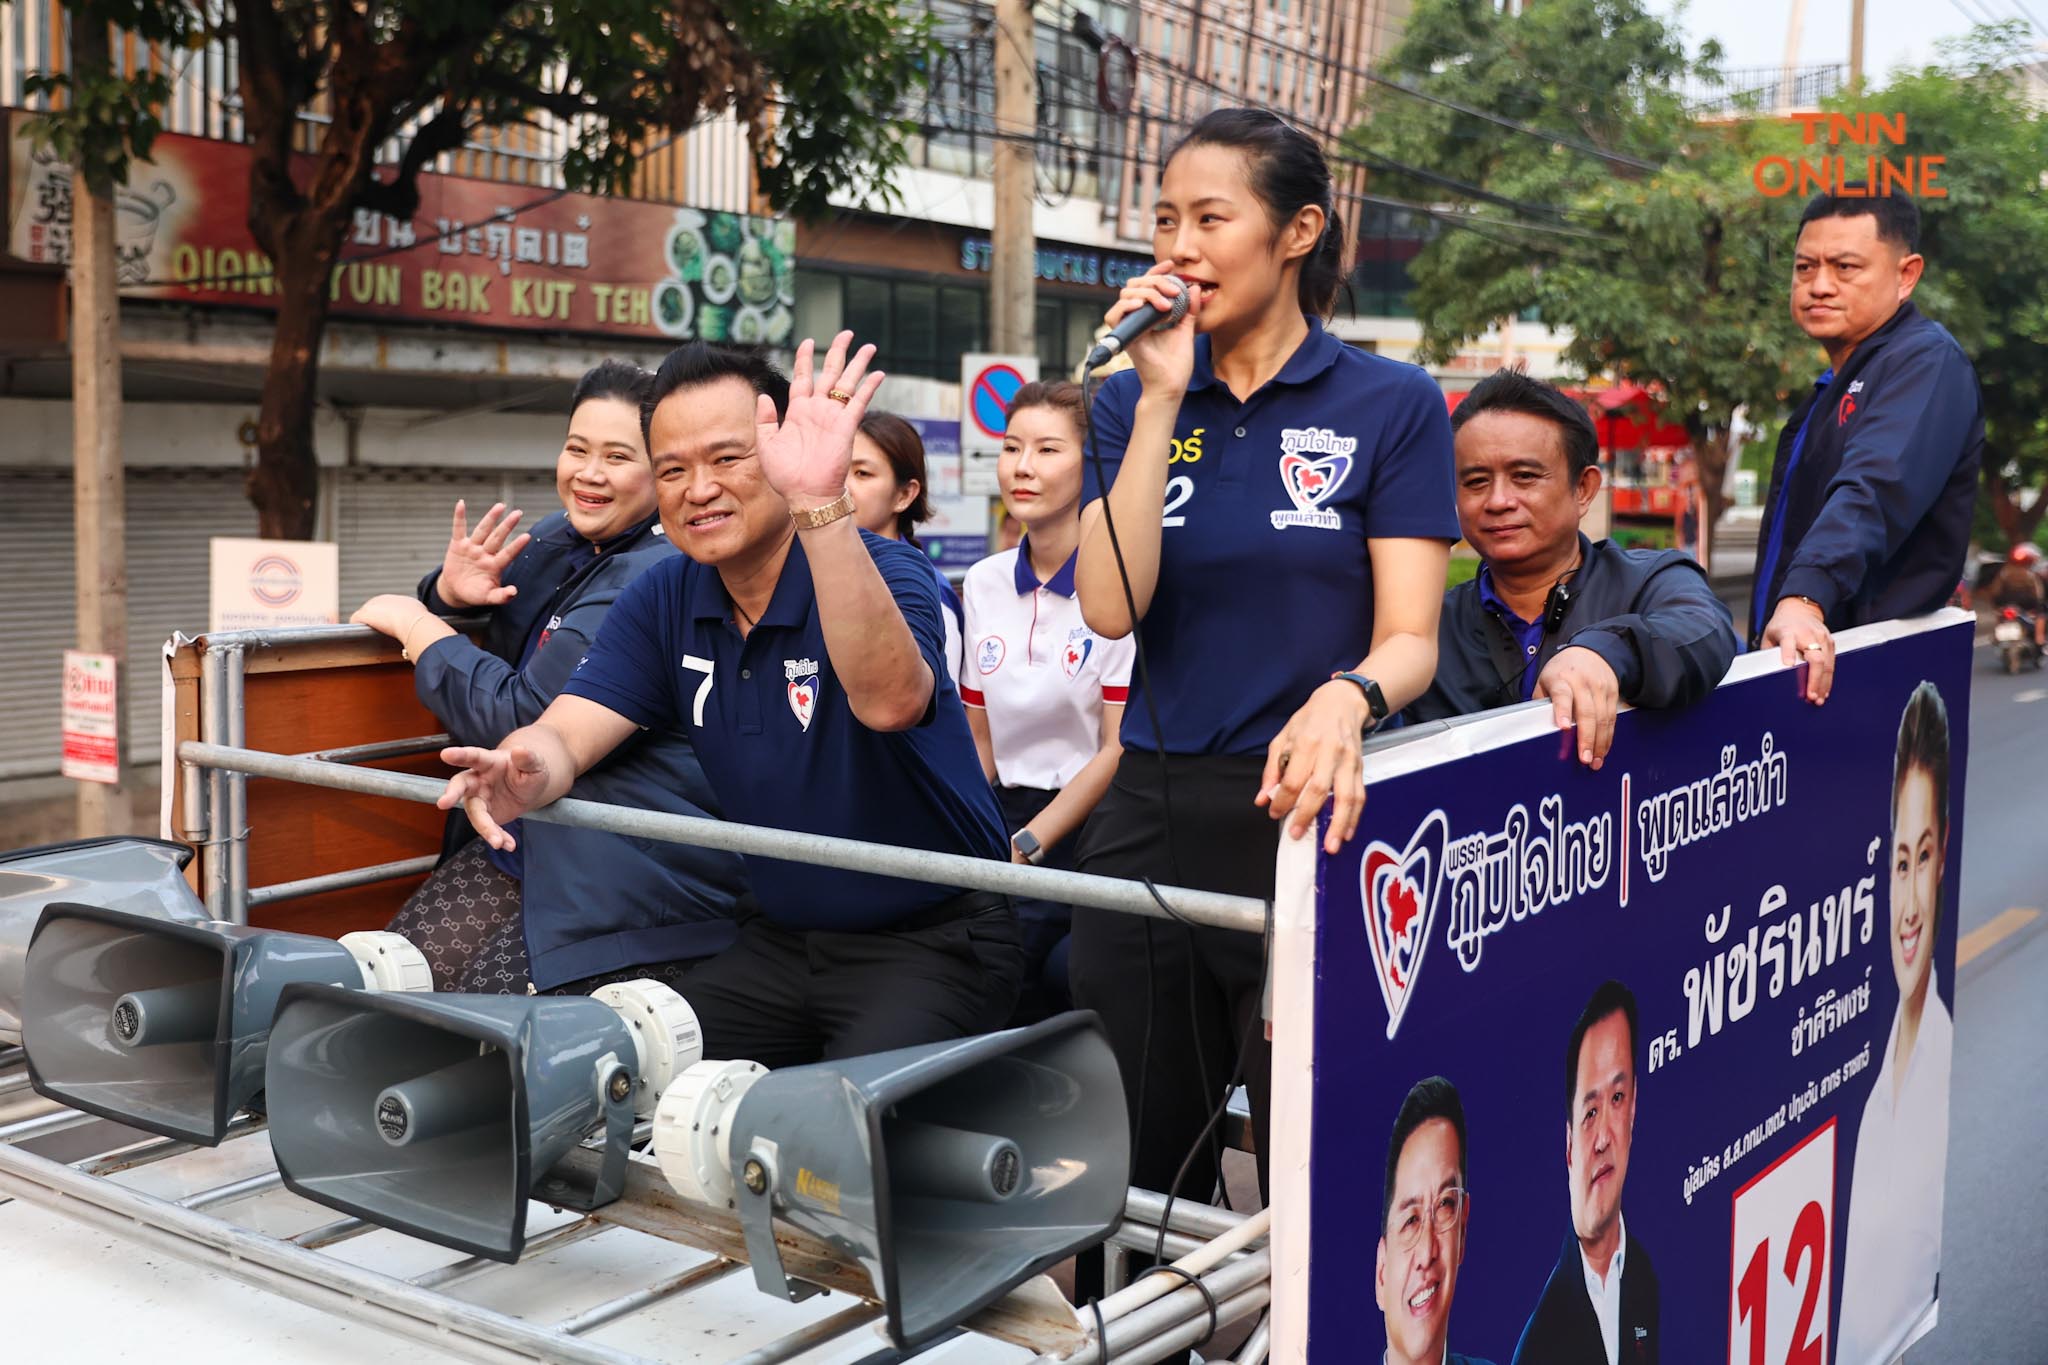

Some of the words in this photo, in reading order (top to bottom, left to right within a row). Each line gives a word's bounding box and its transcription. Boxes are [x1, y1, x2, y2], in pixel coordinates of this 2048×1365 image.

[174, 243, 282, 297] QIAN
[422, 269, 491, 314] BAK
[510, 277, 575, 321] KUT
[591, 283, 650, 326] TEH
[961, 240, 1098, 285] STBUCKS
[1282, 428, 1356, 454] ภูมิใจไทย
[1162, 475, 1194, 528] 2
[681, 654, 715, 727] 7
[1447, 794, 1612, 973] ภูมิใจไทย
[1638, 731, 1787, 883] พูดแล้วทำ
[1447, 833, 1486, 875] พรรค
[1648, 1028, 1682, 1074] ดร.
[1683, 836, 1881, 1049] พัชรินทร์
[1683, 1154, 1720, 1206] ผู้สมัคร
[1788, 1081, 1819, 1123] ปทุมวัน
[1737, 1200, 1825, 1365] 12
